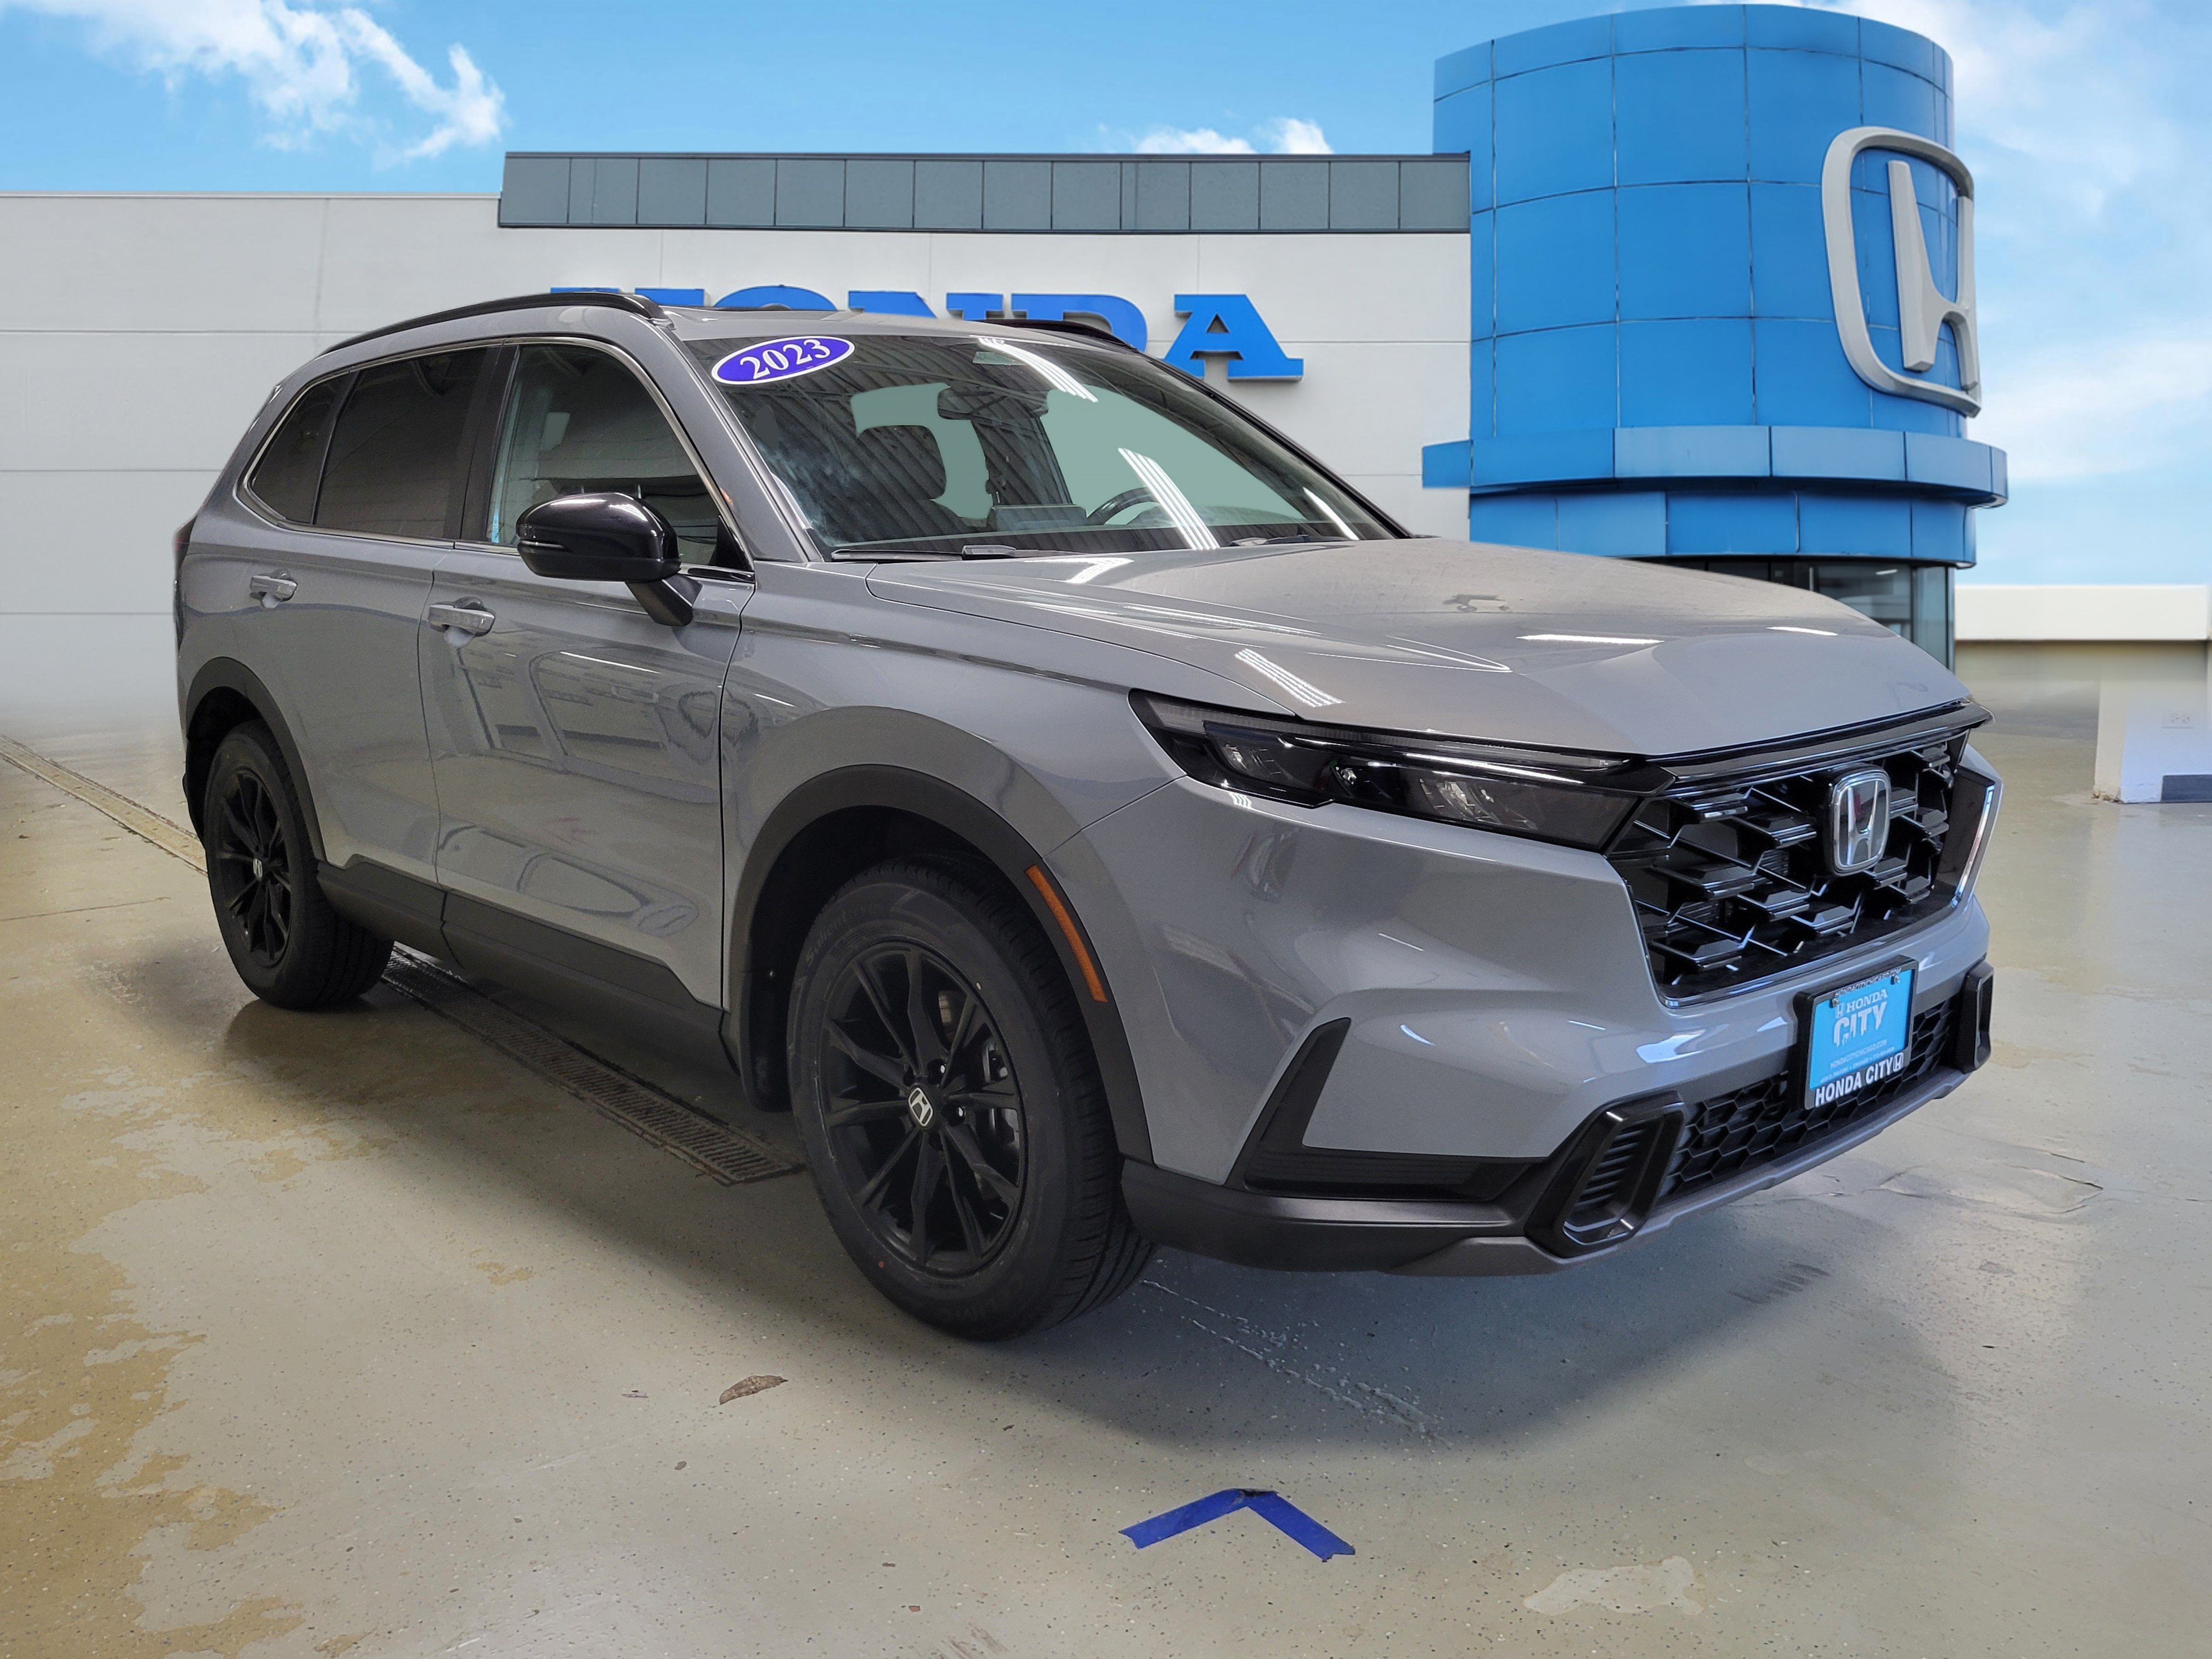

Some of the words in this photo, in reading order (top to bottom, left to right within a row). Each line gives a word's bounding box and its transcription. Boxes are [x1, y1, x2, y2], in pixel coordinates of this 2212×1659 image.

[740, 339, 831, 379] 2023
[1846, 989, 1887, 1013] HONDA
[1834, 1001, 1887, 1047] CITY
[1815, 1071, 1862, 1108] HONDA
[1865, 1057, 1893, 1085] CITY
